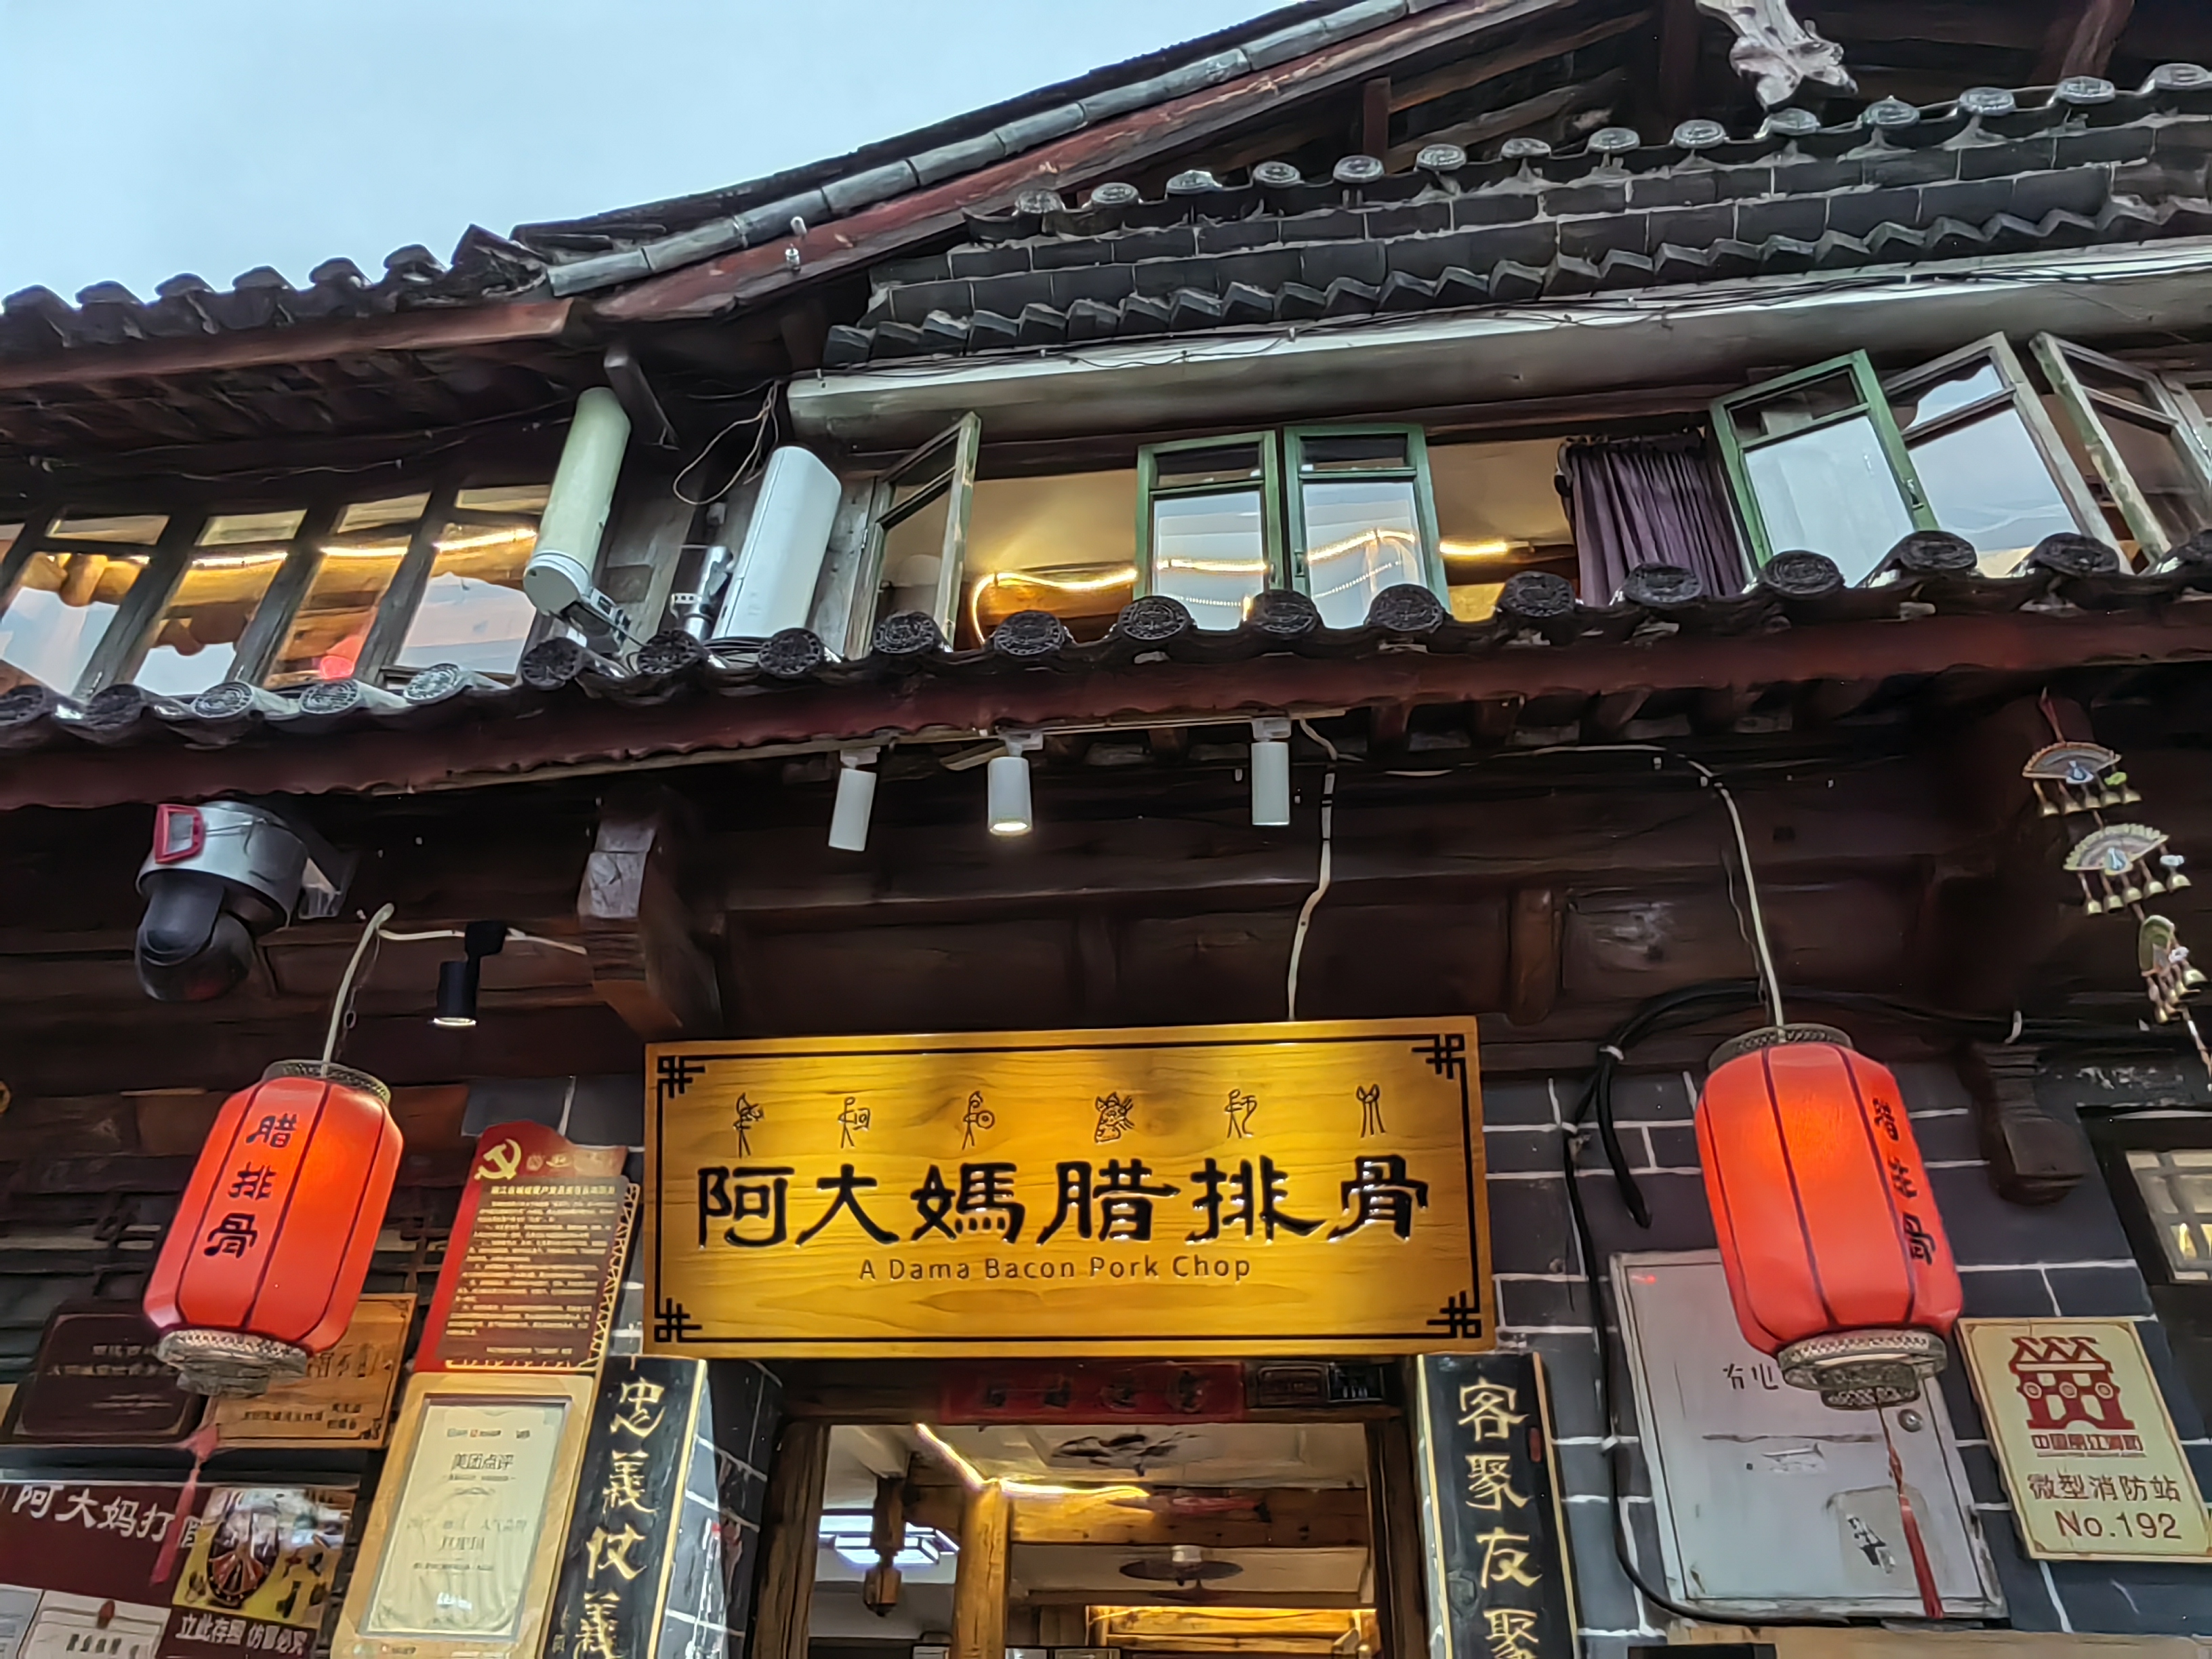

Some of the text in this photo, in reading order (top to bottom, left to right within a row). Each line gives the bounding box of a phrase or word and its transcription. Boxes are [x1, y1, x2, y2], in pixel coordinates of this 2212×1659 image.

[203, 1112, 299, 1258] 腊排骨
[697, 1152, 1430, 1249] 阿大媽腊排骨
[859, 1255, 1251, 1282] A Dama Bacon Pork Chop
[2028, 1473, 2181, 1502] 微型消防站
[2054, 1510, 2182, 1540] No.192
